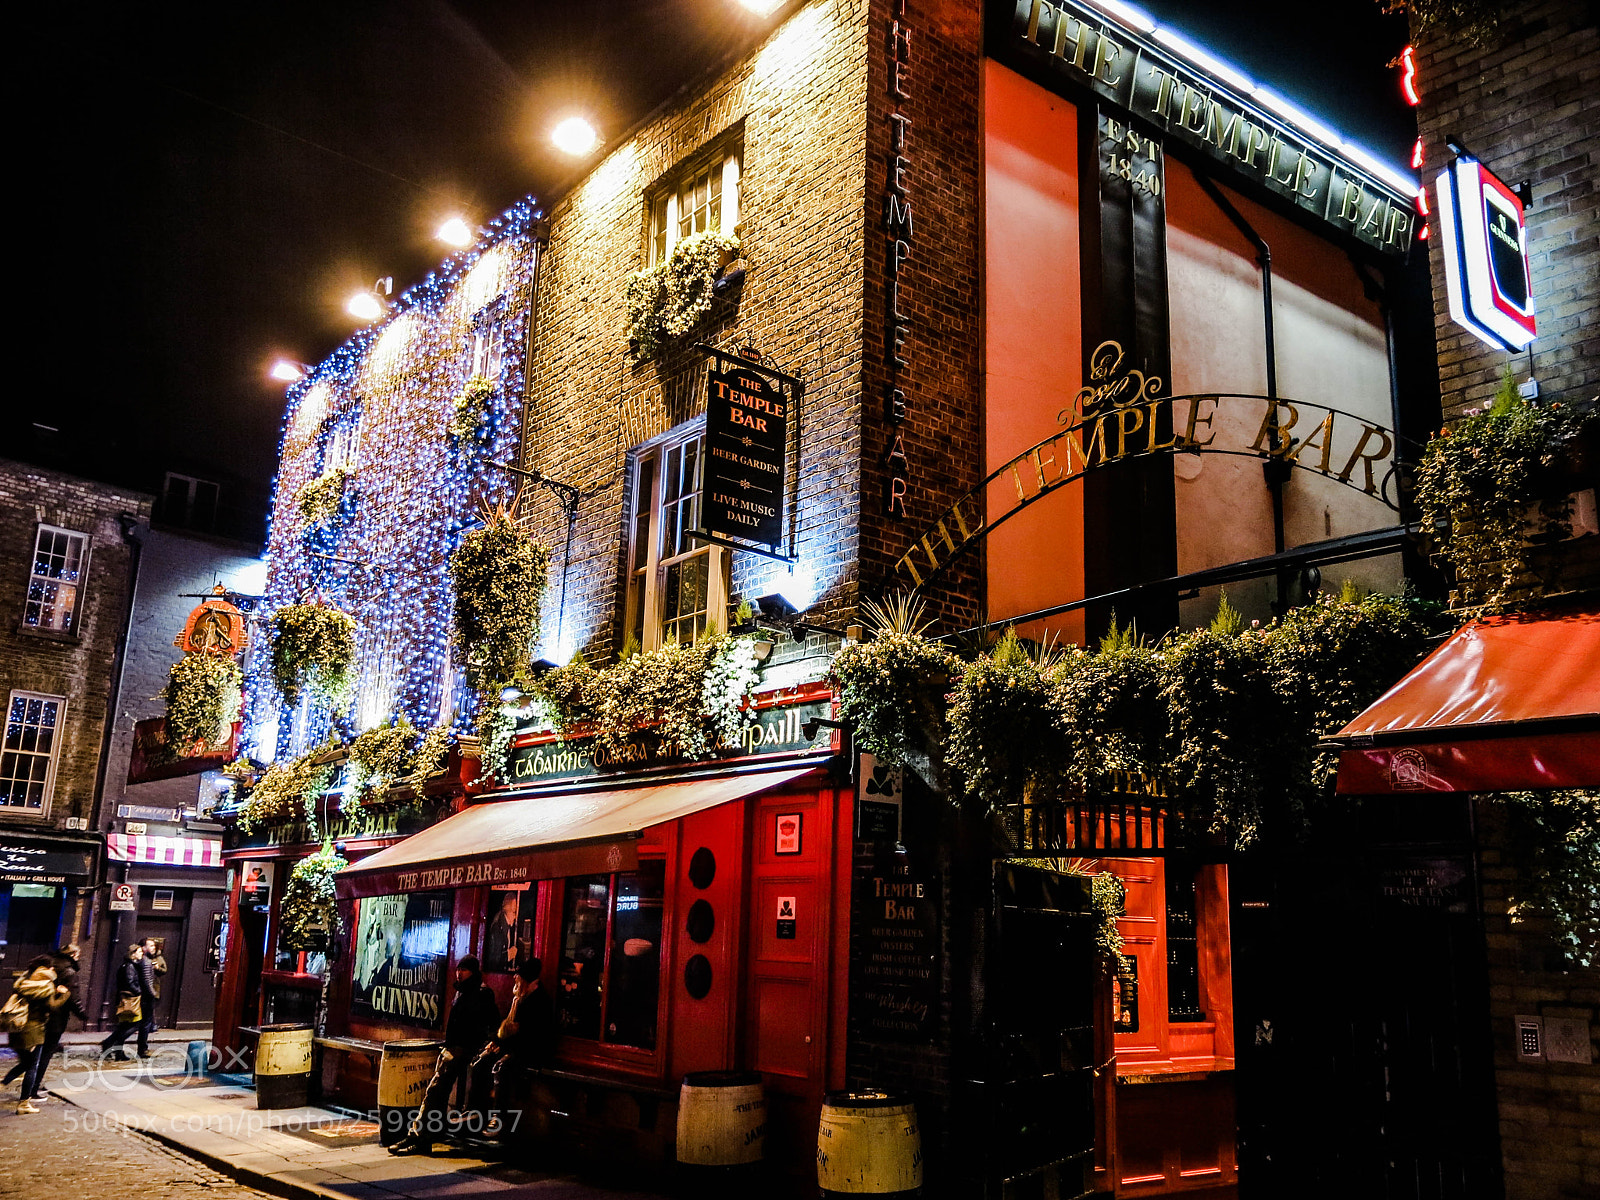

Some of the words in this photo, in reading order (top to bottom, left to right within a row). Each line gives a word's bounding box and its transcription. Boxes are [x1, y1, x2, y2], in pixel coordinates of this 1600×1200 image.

[1020, 0, 1124, 90] THE
[1148, 64, 1320, 200] TEMPLE
[1336, 177, 1412, 254] BAR
[1106, 117, 1160, 162] EST
[1108, 153, 1161, 196] 1840
[887, 113, 912, 366] TEMPLE
[1489, 221, 1520, 252] GUINNESS
[713, 380, 784, 418] TEMPLE
[737, 376, 762, 393] THE
[729, 406, 768, 433] BAR
[712, 447, 738, 463] BEER
[739, 455, 780, 475] GARDEN
[884, 388, 909, 518] BAR
[712, 492, 739, 508] LIVE
[740, 499, 775, 518] MUSIC
[894, 492, 983, 588] THE
[999, 395, 1220, 503] TEMPLE
[1245, 398, 1394, 497] BAR
[726, 509, 760, 528] DAILY
[267, 823, 295, 846] THE
[363, 811, 399, 836] BAR
[0, 846, 48, 855] exico
[397, 874, 418, 891] THE
[420, 867, 465, 888] TEMPLE
[465, 863, 493, 884] BAR
[510, 867, 527, 879] 1840
[872, 876, 925, 899] TEMPLE
[383, 902, 398, 918] BAR
[884, 898, 916, 921] BAR
[372, 985, 439, 1022] GUINNESS
